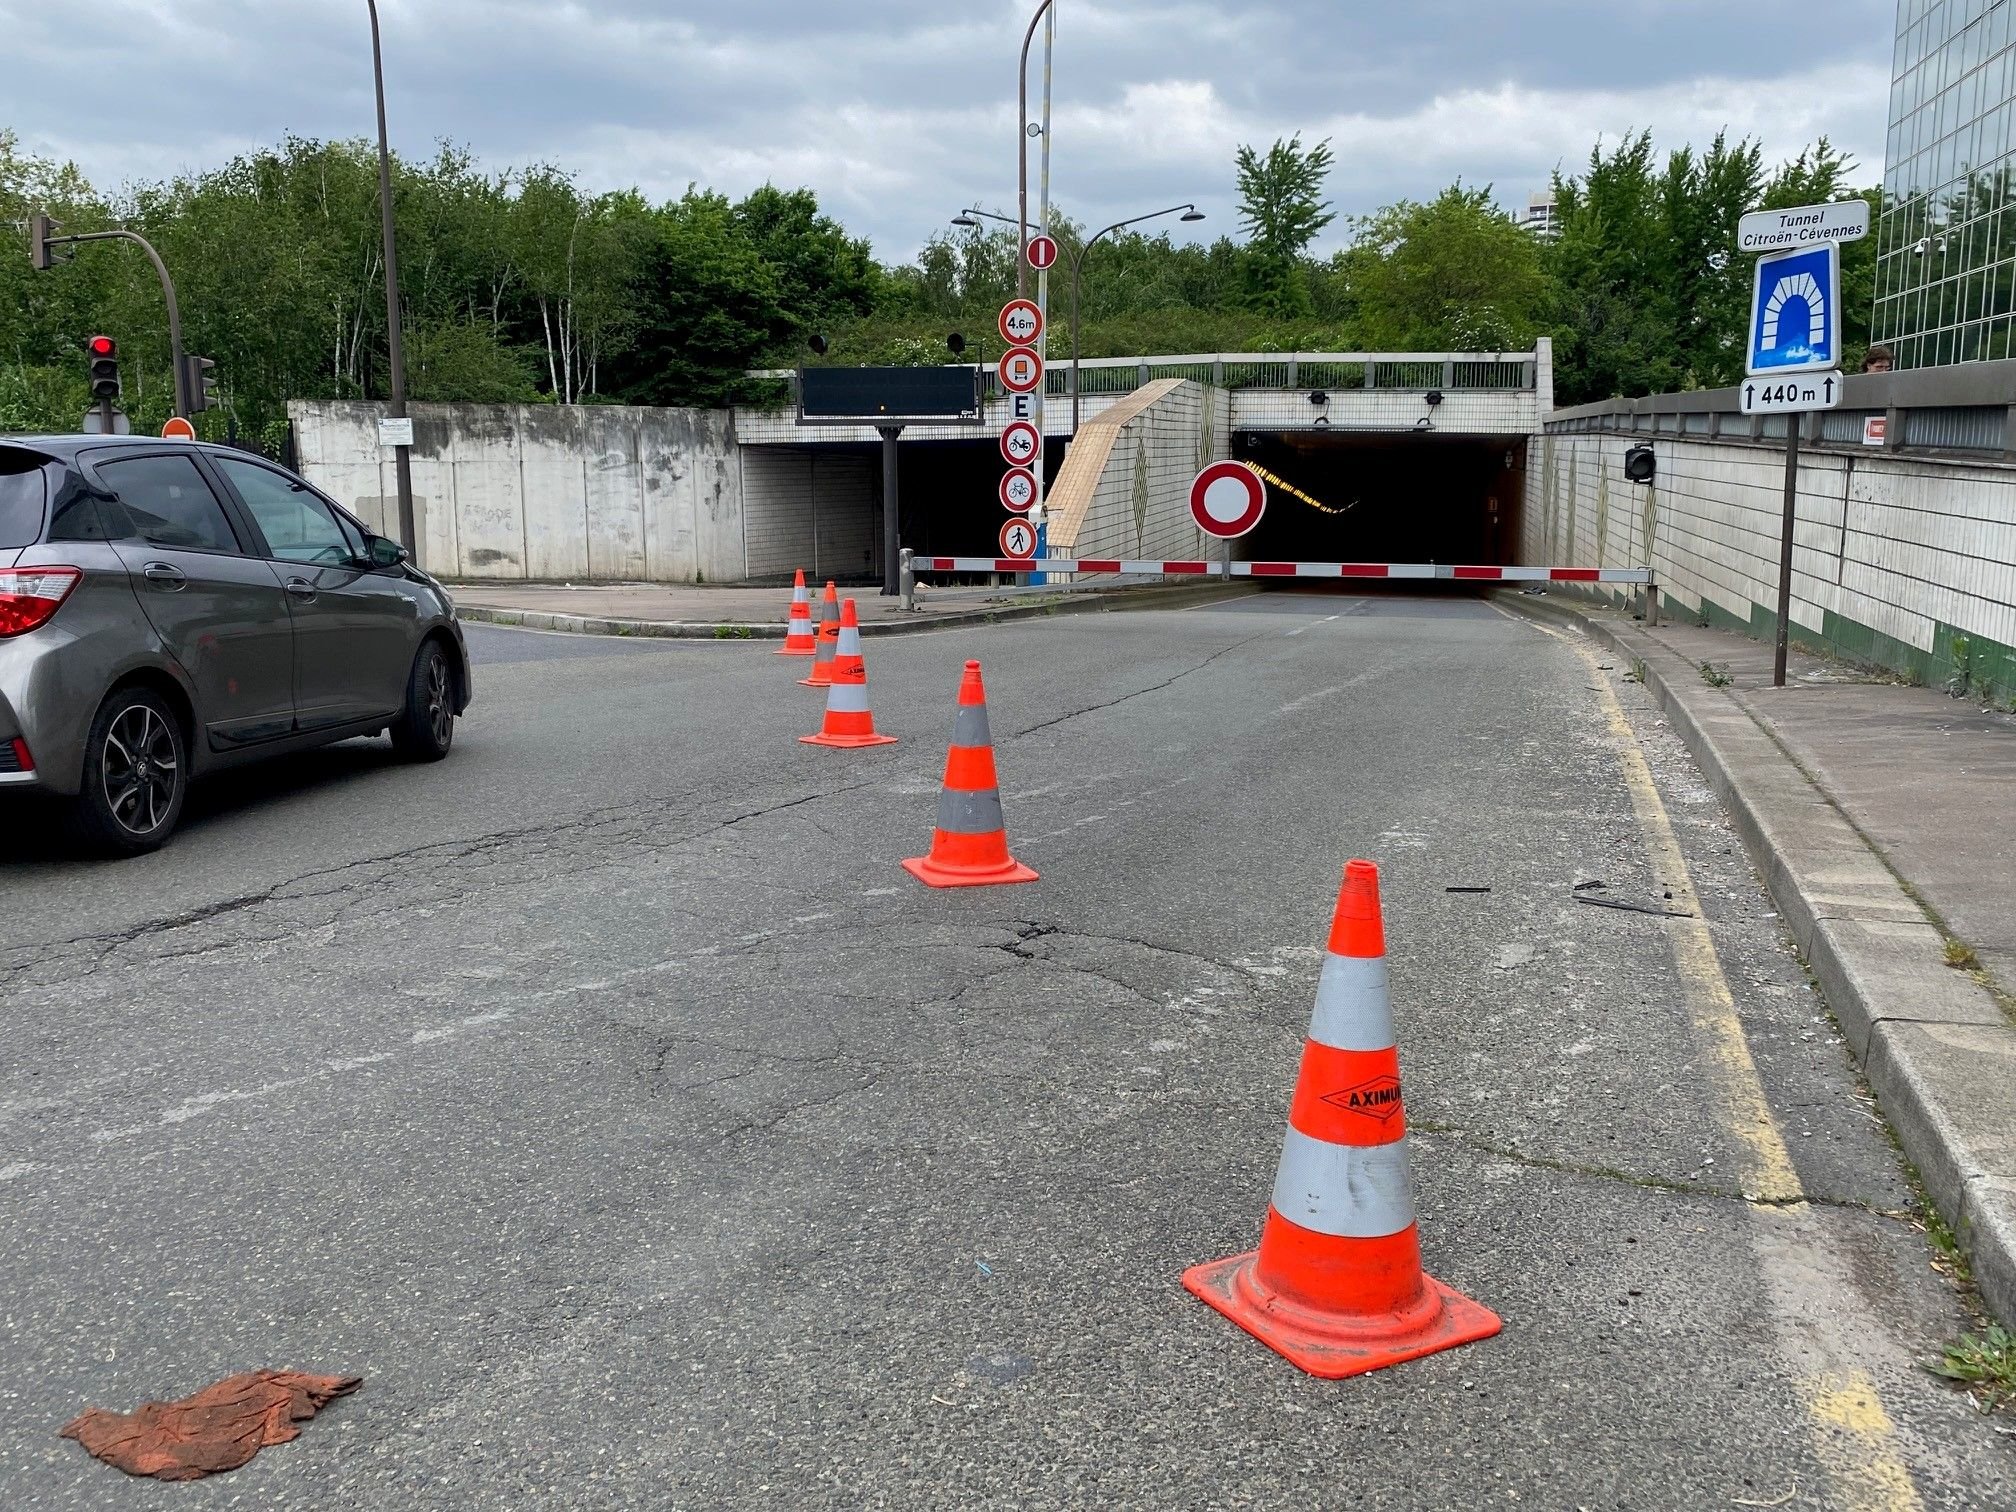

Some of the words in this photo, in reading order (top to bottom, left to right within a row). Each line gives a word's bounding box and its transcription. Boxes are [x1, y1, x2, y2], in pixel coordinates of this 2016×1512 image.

[1780, 211, 1825, 228] Tunnel
[1744, 224, 1863, 247] Citroën-Cévennes
[1007, 316, 1035, 330] 4.6m
[1761, 384, 1798, 404] 440
[1802, 389, 1816, 402] m
[1014, 395, 1029, 418] E
